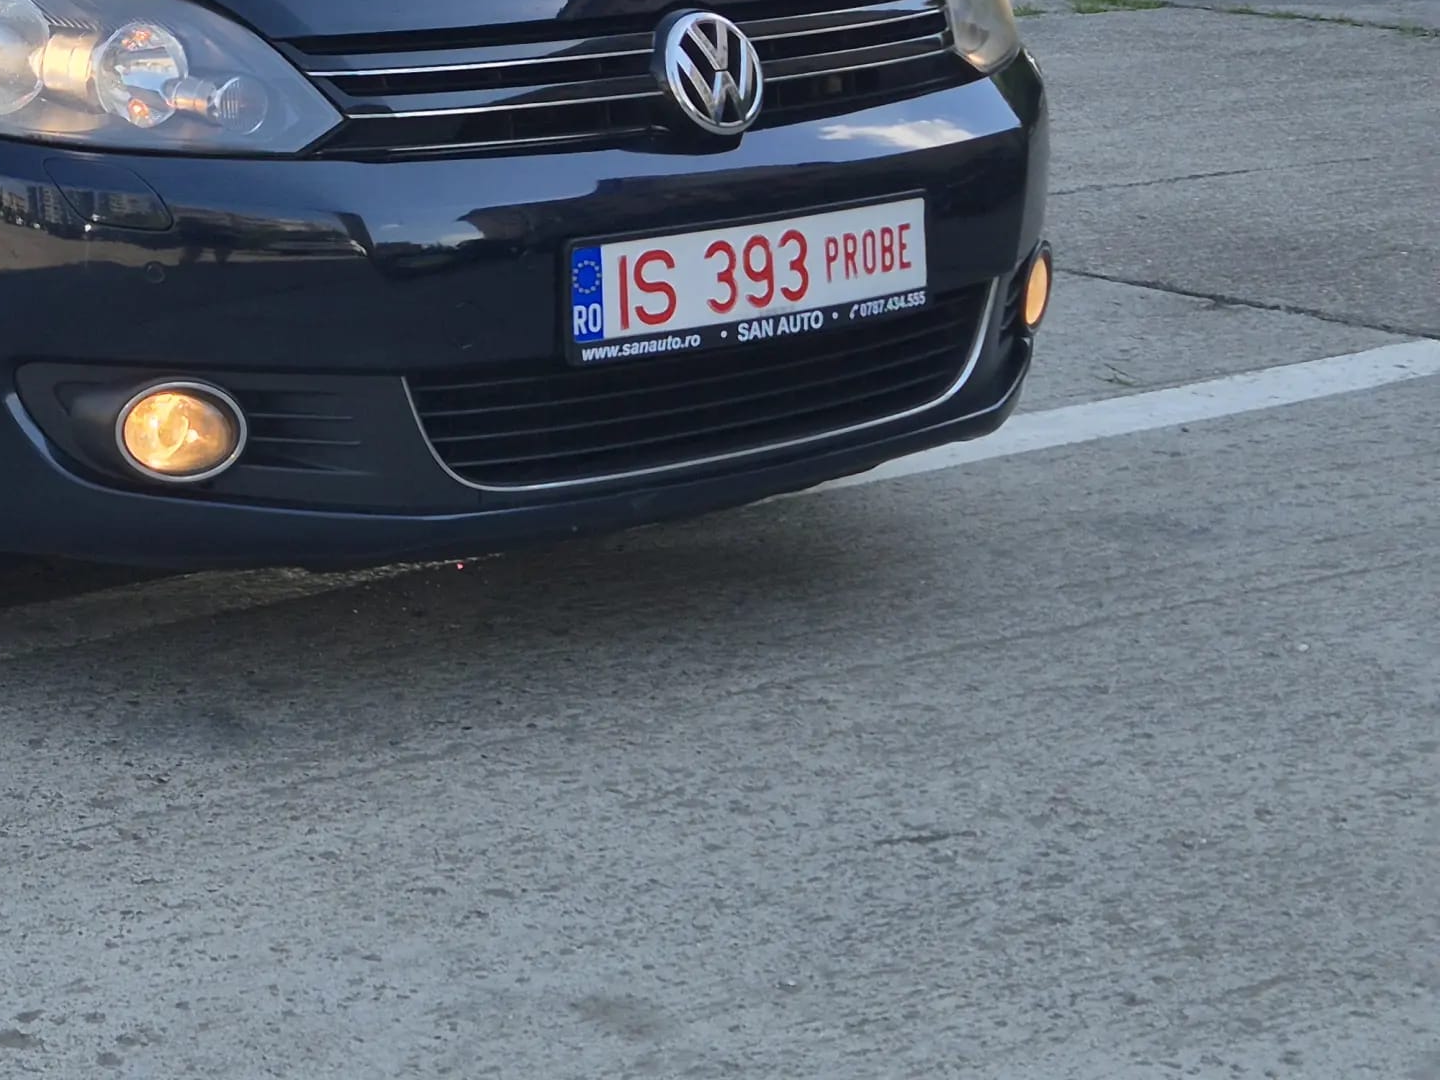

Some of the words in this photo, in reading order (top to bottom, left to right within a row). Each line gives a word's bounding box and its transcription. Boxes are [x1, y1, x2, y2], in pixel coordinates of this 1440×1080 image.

[617, 249, 677, 331] IS
[704, 229, 809, 315] 393
[824, 223, 911, 283] PROBE
[573, 303, 602, 336] RO
[581, 333, 701, 362] www.sanauto.ro
[737, 317, 775, 342] SAN
[776, 310, 824, 336] AUTO
